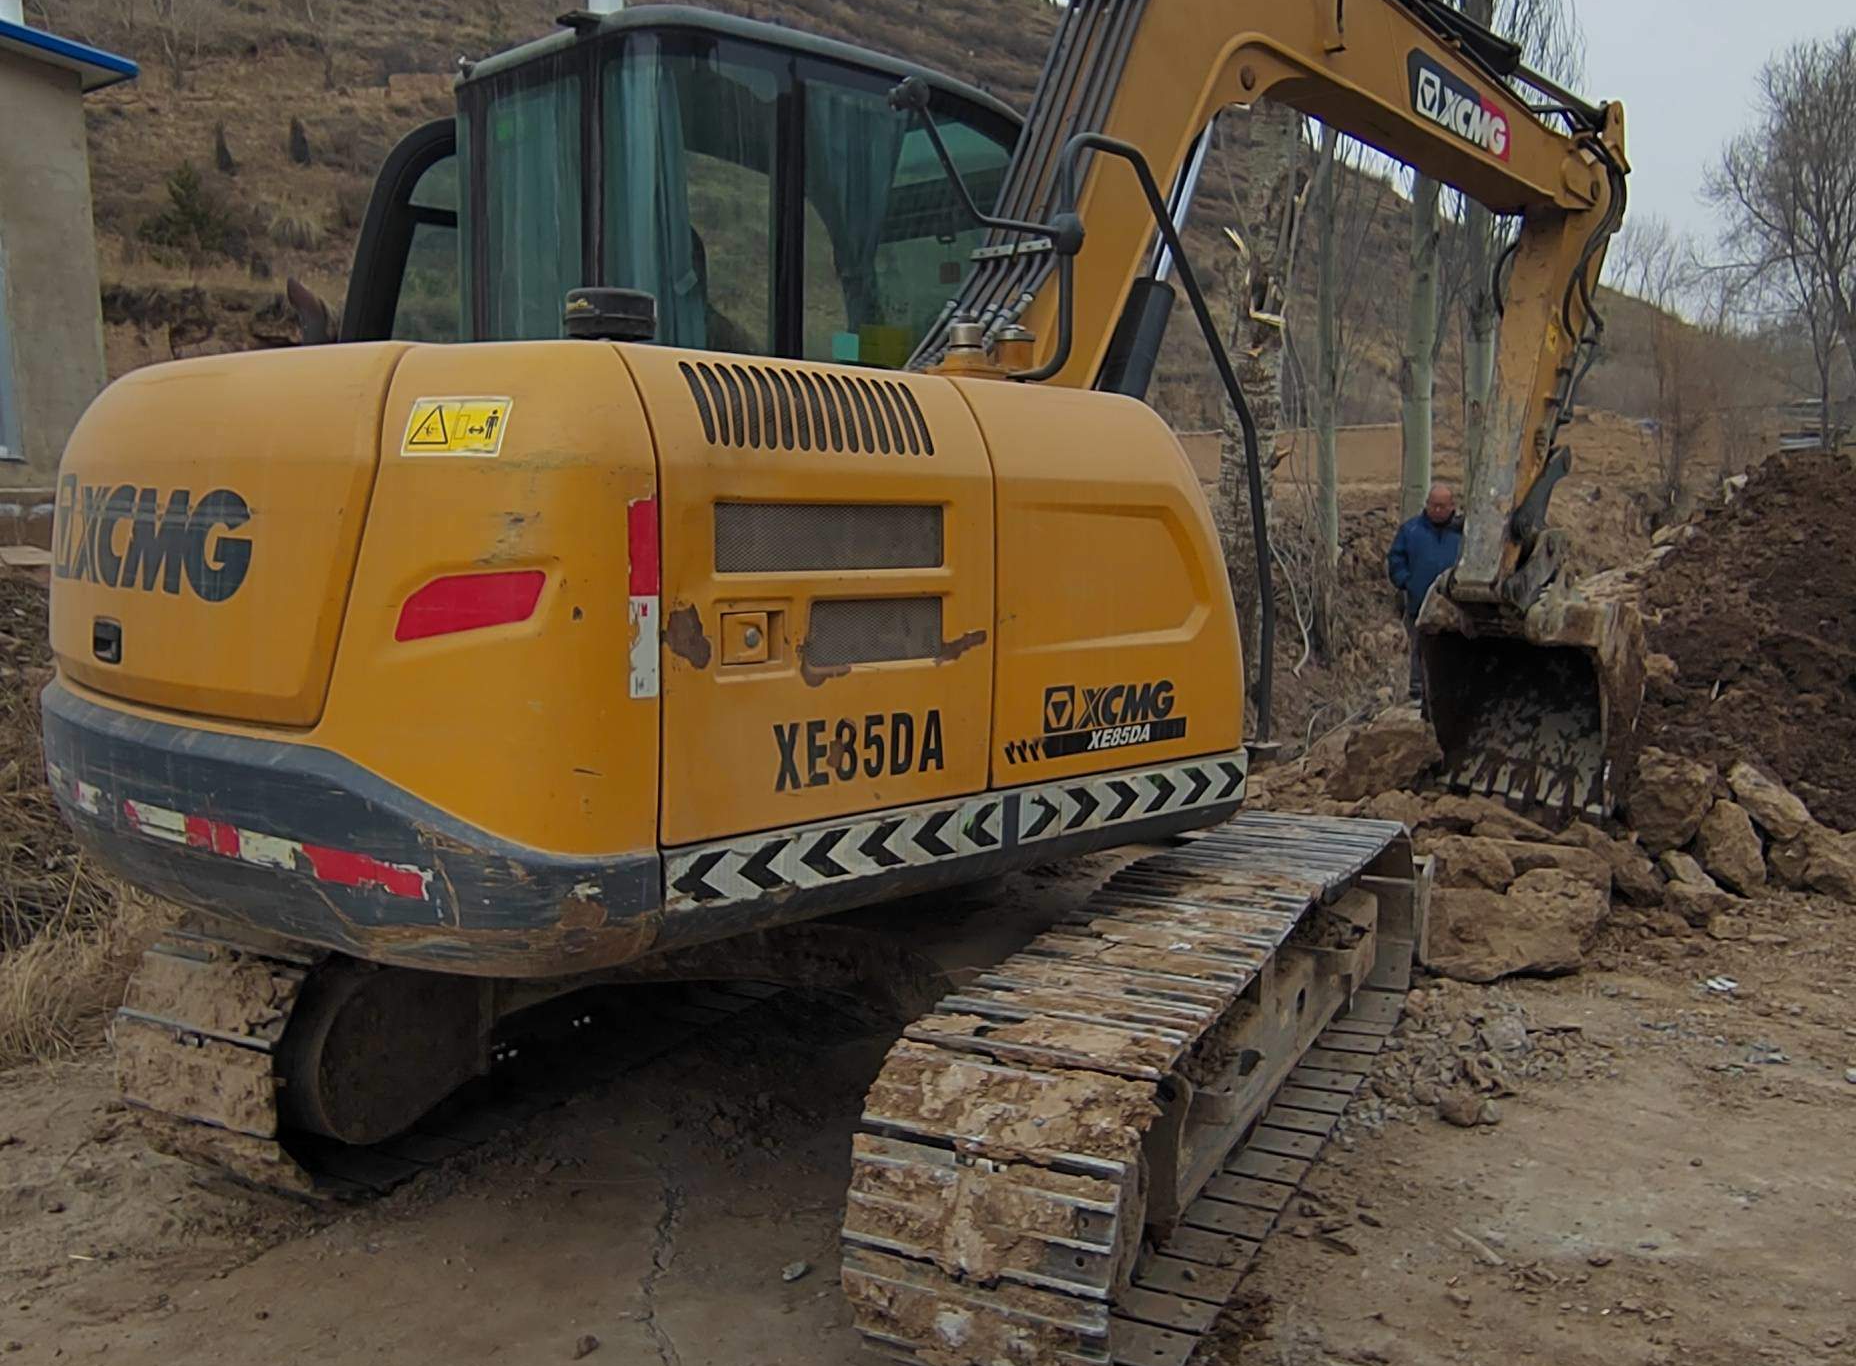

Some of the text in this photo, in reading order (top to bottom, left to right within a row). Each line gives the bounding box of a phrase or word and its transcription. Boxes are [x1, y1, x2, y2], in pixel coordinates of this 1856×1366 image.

[1437, 86, 1507, 155] XCMG
[74, 483, 252, 602] XCMG
[1075, 680, 1175, 729] XCMG
[1087, 722, 1151, 751] XE85DA
[773, 709, 944, 793] XE85DA
